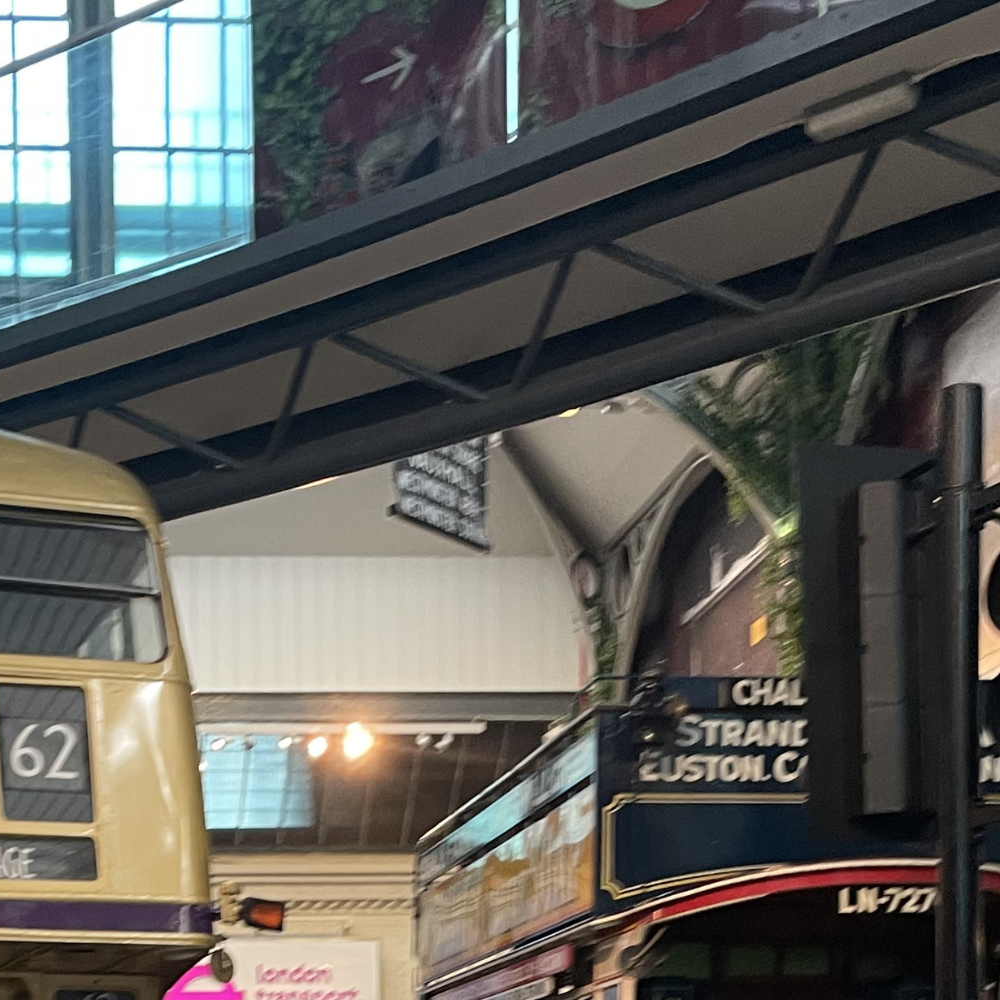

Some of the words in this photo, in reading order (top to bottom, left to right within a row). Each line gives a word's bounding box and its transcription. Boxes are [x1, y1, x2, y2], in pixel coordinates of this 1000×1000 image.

[732, 678, 809, 706] CHAL
[9, 723, 79, 779] 62
[838, 886, 937, 914] LN-727
[255, 963, 333, 985] london
